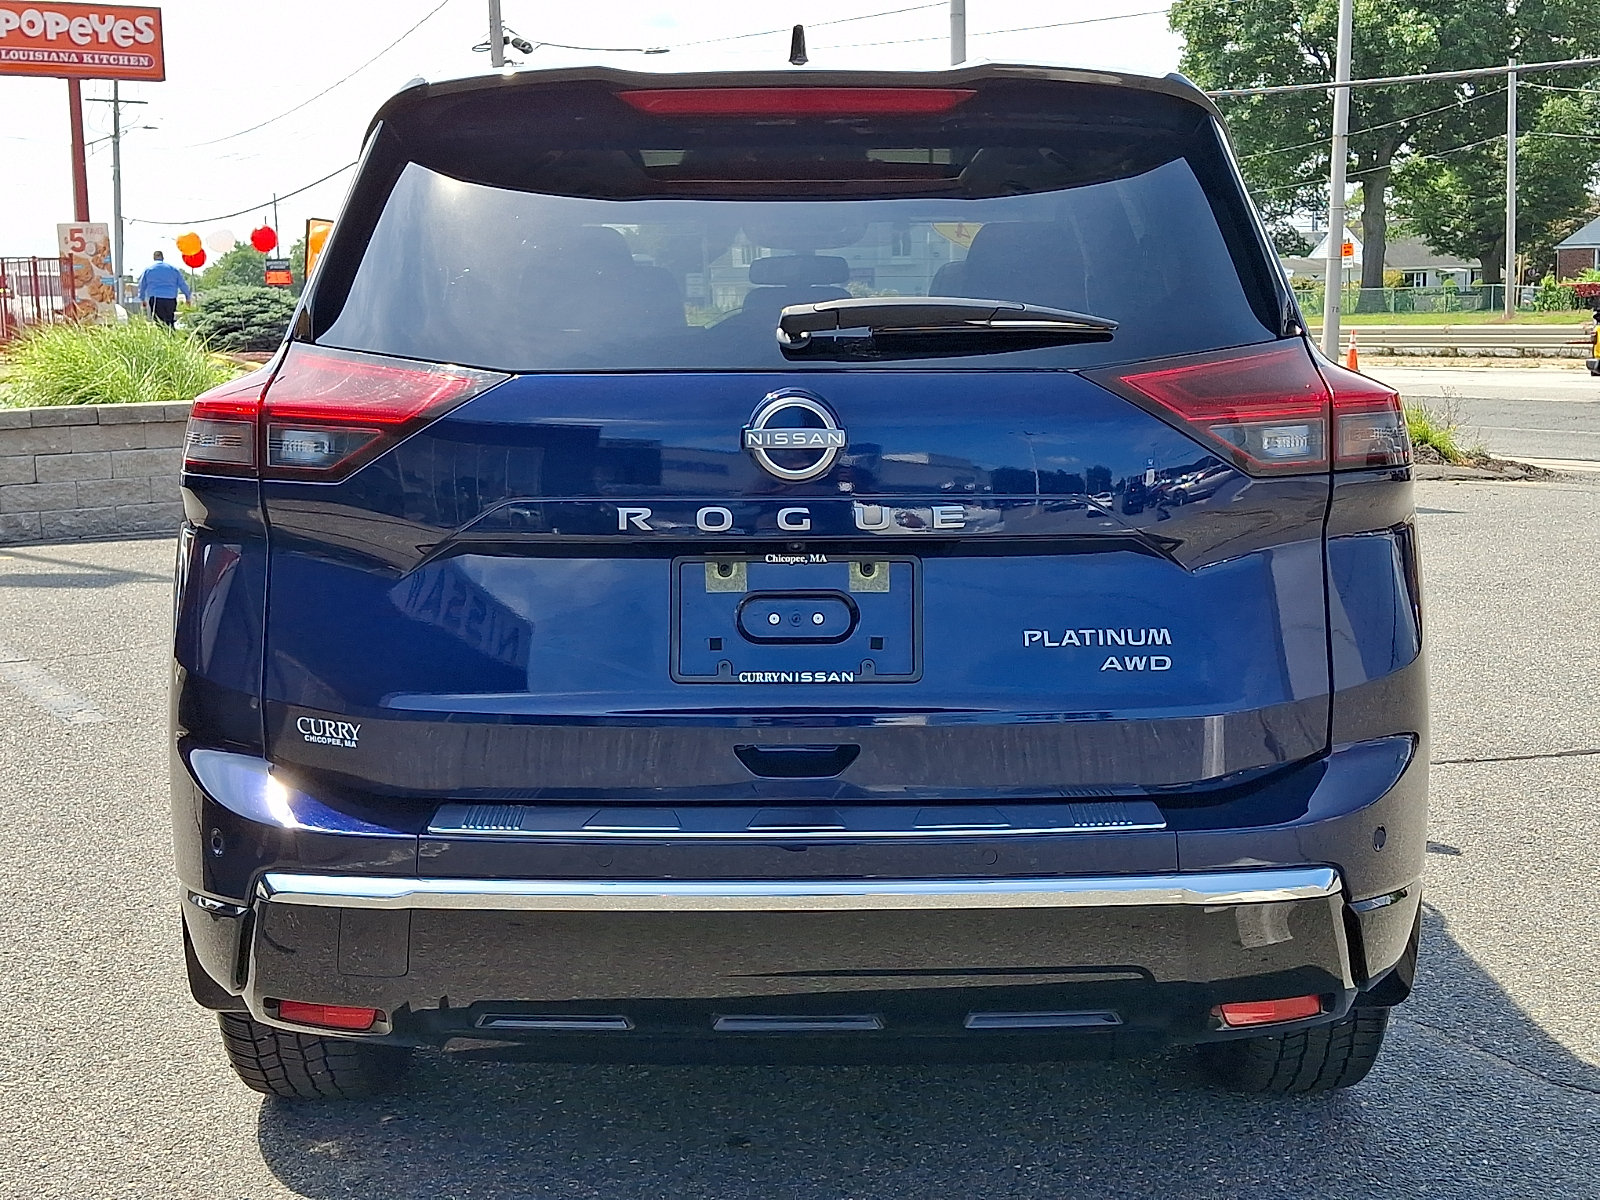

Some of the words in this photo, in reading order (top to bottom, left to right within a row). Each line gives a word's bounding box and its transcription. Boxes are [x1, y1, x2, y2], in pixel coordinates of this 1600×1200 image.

[1, 50, 78, 63] LOUISIANA
[82, 54, 149, 67] KITCHEN
[747, 431, 844, 446] NISSAN
[617, 505, 966, 532] ROGUE
[765, 553, 808, 565] Chicopee,
[810, 554, 828, 564] MA
[1023, 628, 1172, 647] PLATINUM
[1100, 656, 1172, 671] AWD
[296, 716, 361, 741] CURRY
[304, 734, 344, 748] CHICOPEE,
[344, 739, 357, 748] MA
